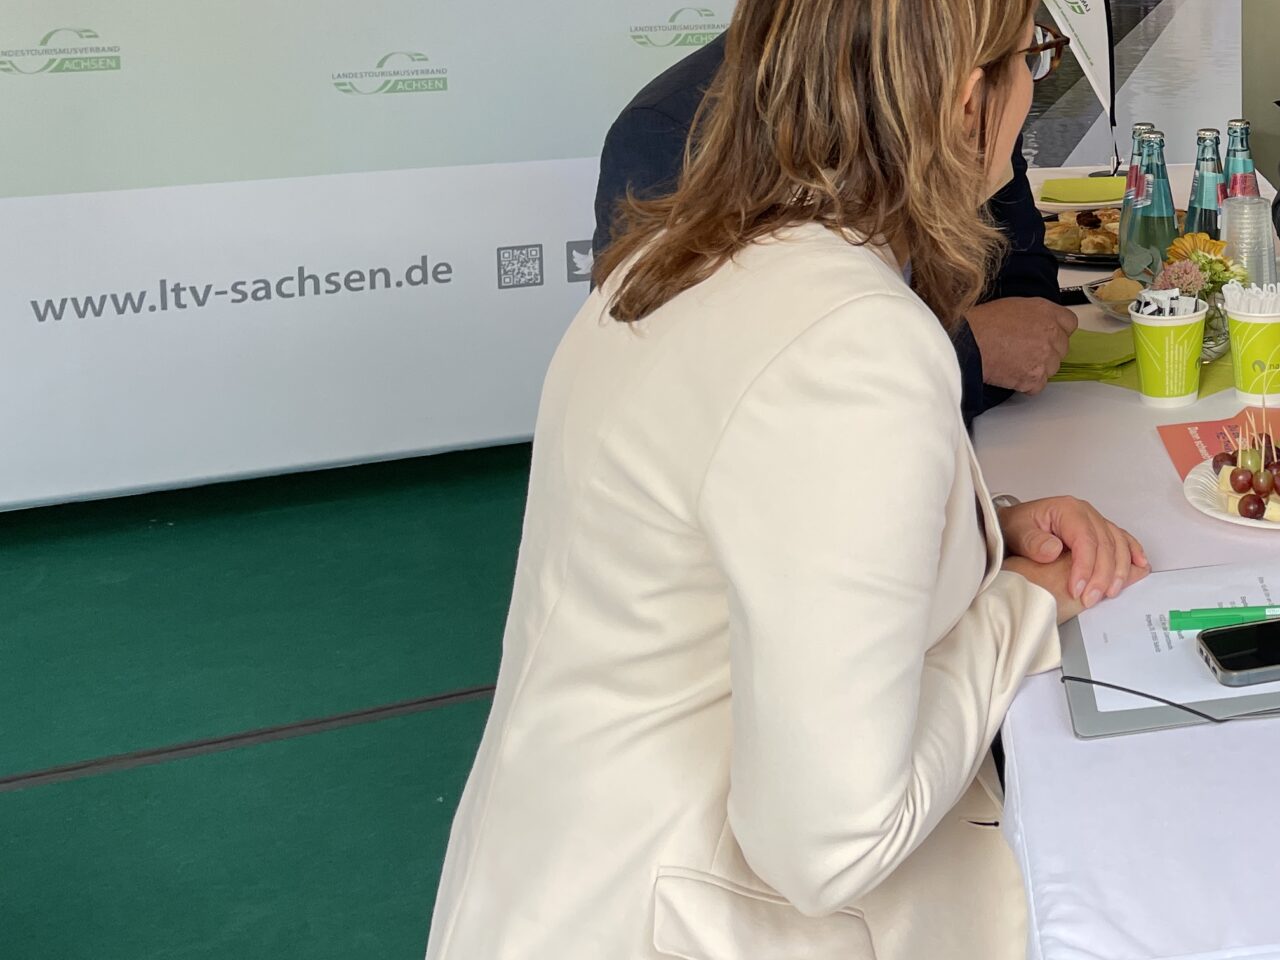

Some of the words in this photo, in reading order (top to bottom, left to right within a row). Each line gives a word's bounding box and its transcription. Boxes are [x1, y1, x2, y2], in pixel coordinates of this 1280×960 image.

[62, 58, 117, 70] ACHSEN
[396, 80, 444, 91] ACHSEN
[30, 255, 454, 324] www.ltv-sachsen.de
